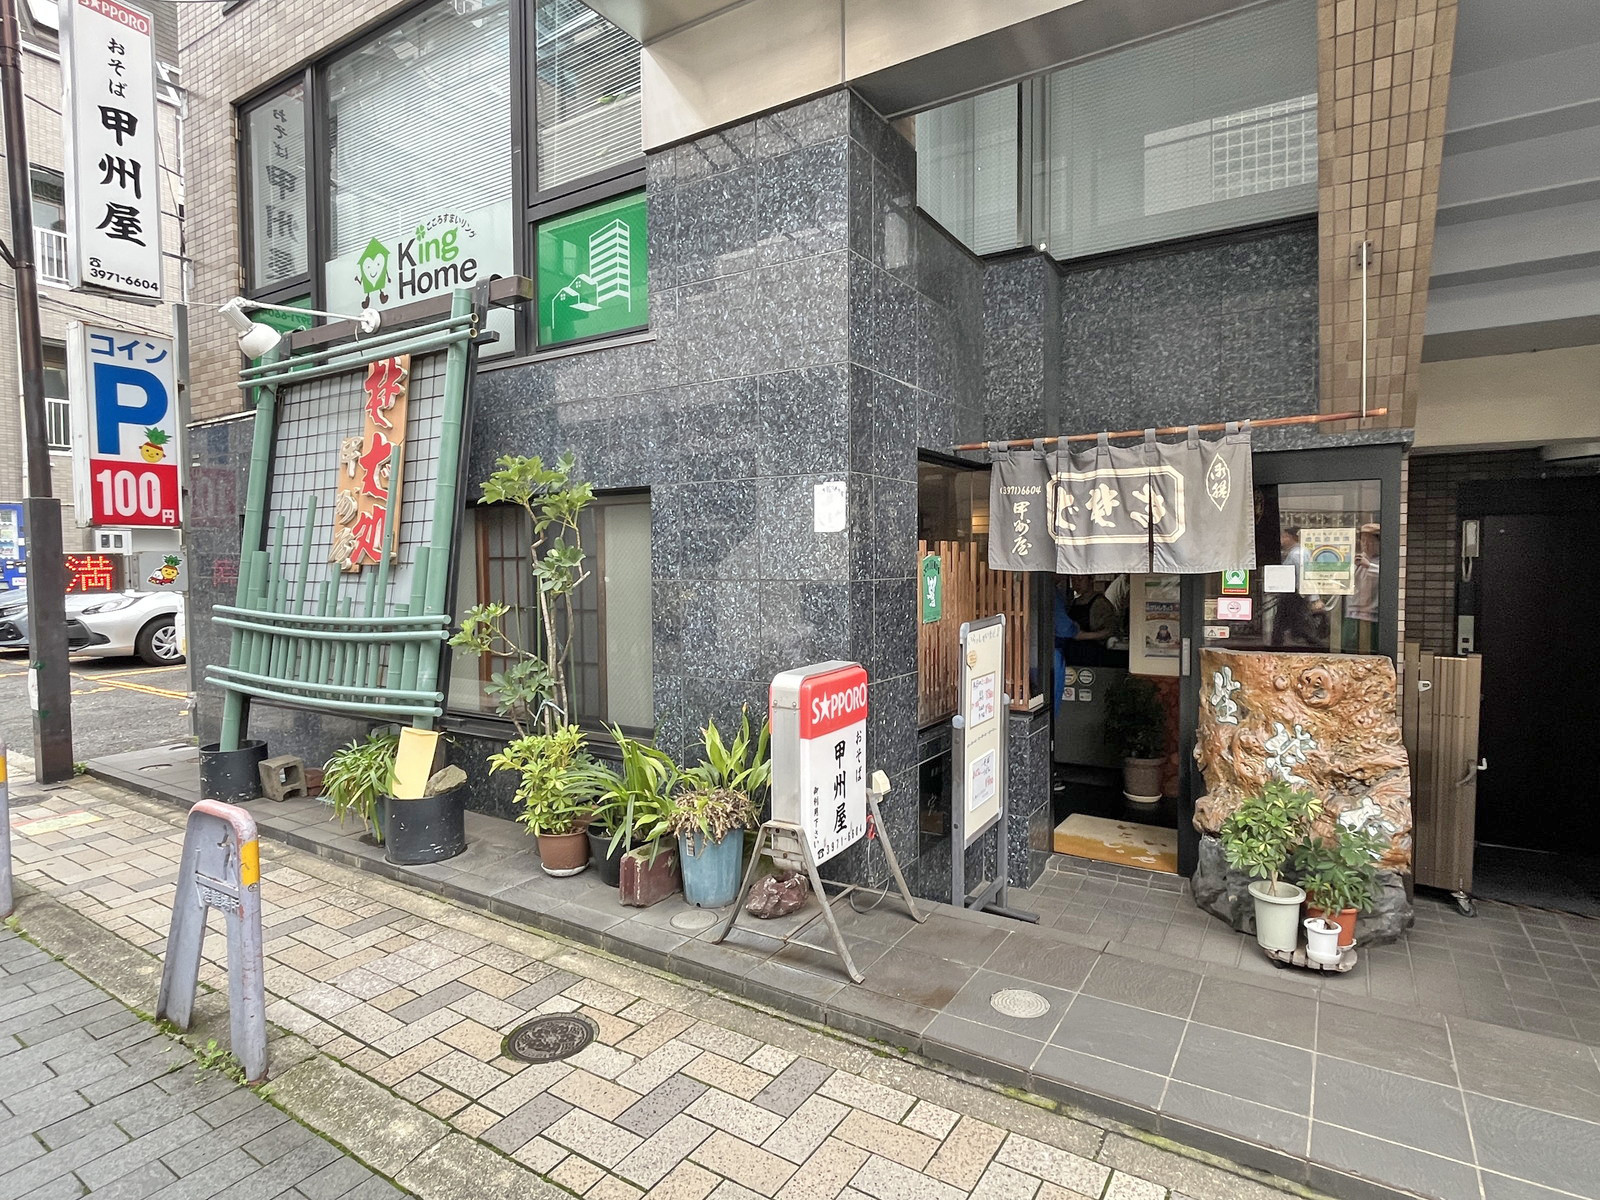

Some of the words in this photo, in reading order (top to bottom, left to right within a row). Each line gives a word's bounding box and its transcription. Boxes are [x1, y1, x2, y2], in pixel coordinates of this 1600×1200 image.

[107, 38, 126, 98] おそば
[96, 105, 147, 247] 甲州屋
[398, 226, 459, 271] King
[90, 268, 159, 292] 3971-6604
[399, 258, 477, 300] Home
[90, 333, 168, 364] コイン
[94, 362, 169, 455] P
[65, 555, 113, 592] 満
[855, 730, 863, 783] おそば
[833, 739, 848, 834] 甲州屋
[826, 823, 863, 855] 3971-6604
